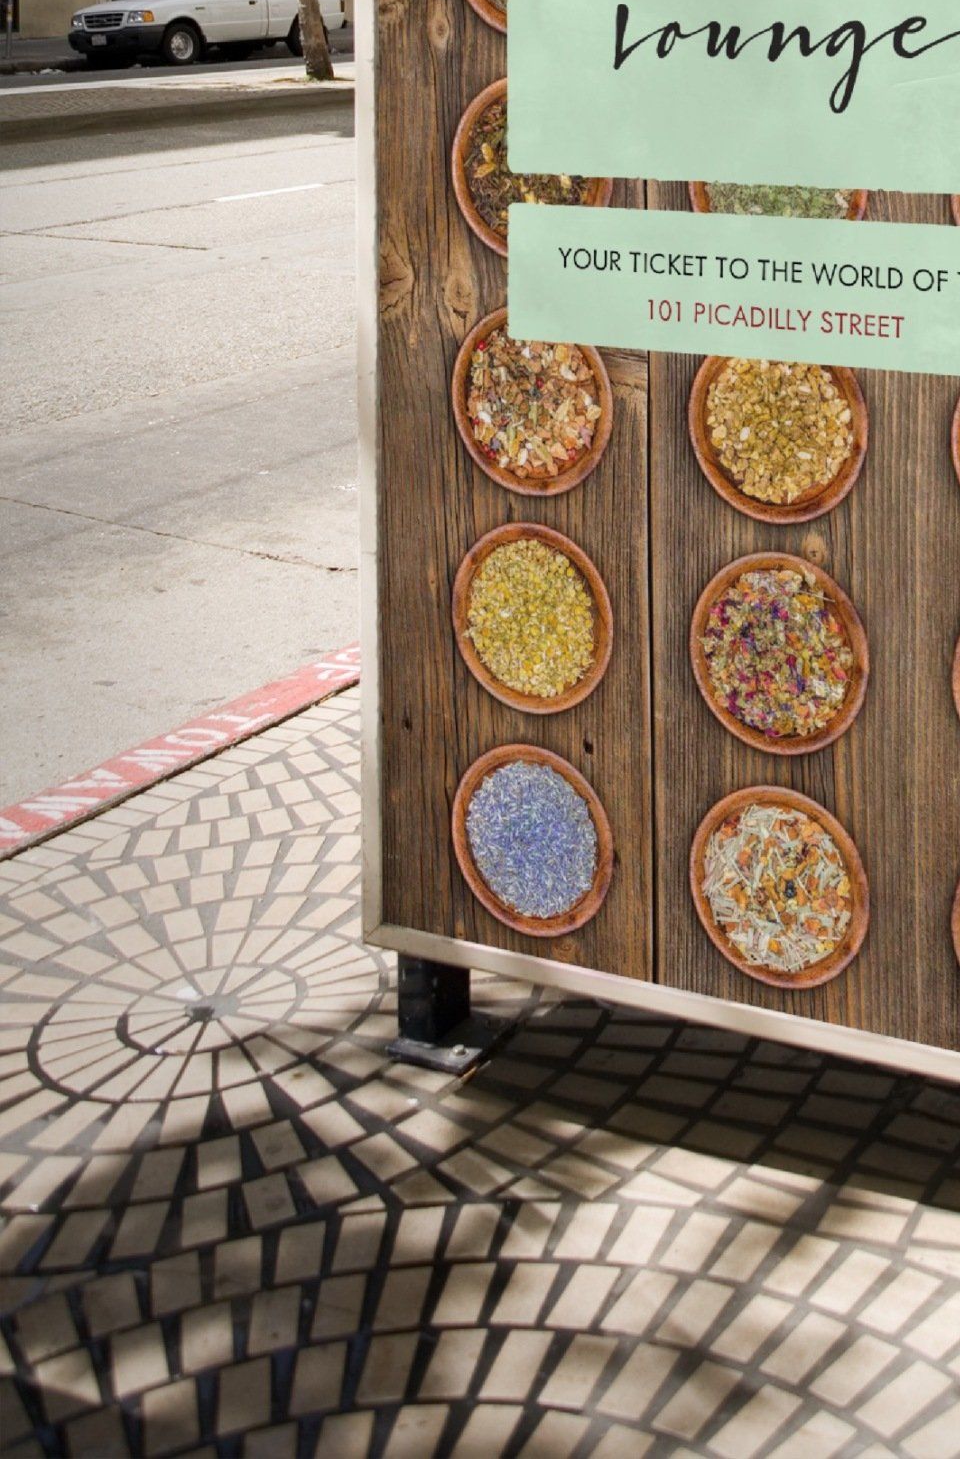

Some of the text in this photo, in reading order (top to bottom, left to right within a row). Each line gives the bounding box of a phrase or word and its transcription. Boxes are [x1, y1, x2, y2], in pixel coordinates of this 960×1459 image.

[558, 246, 622, 272] YOUR
[629, 251, 708, 278] TICKET
[715, 256, 749, 280] TO
[757, 259, 803, 284] THE
[811, 263, 904, 290] WORLD
[912, 268, 949, 293] OF
[648, 298, 905, 339] 101 PICADILLY STREET
